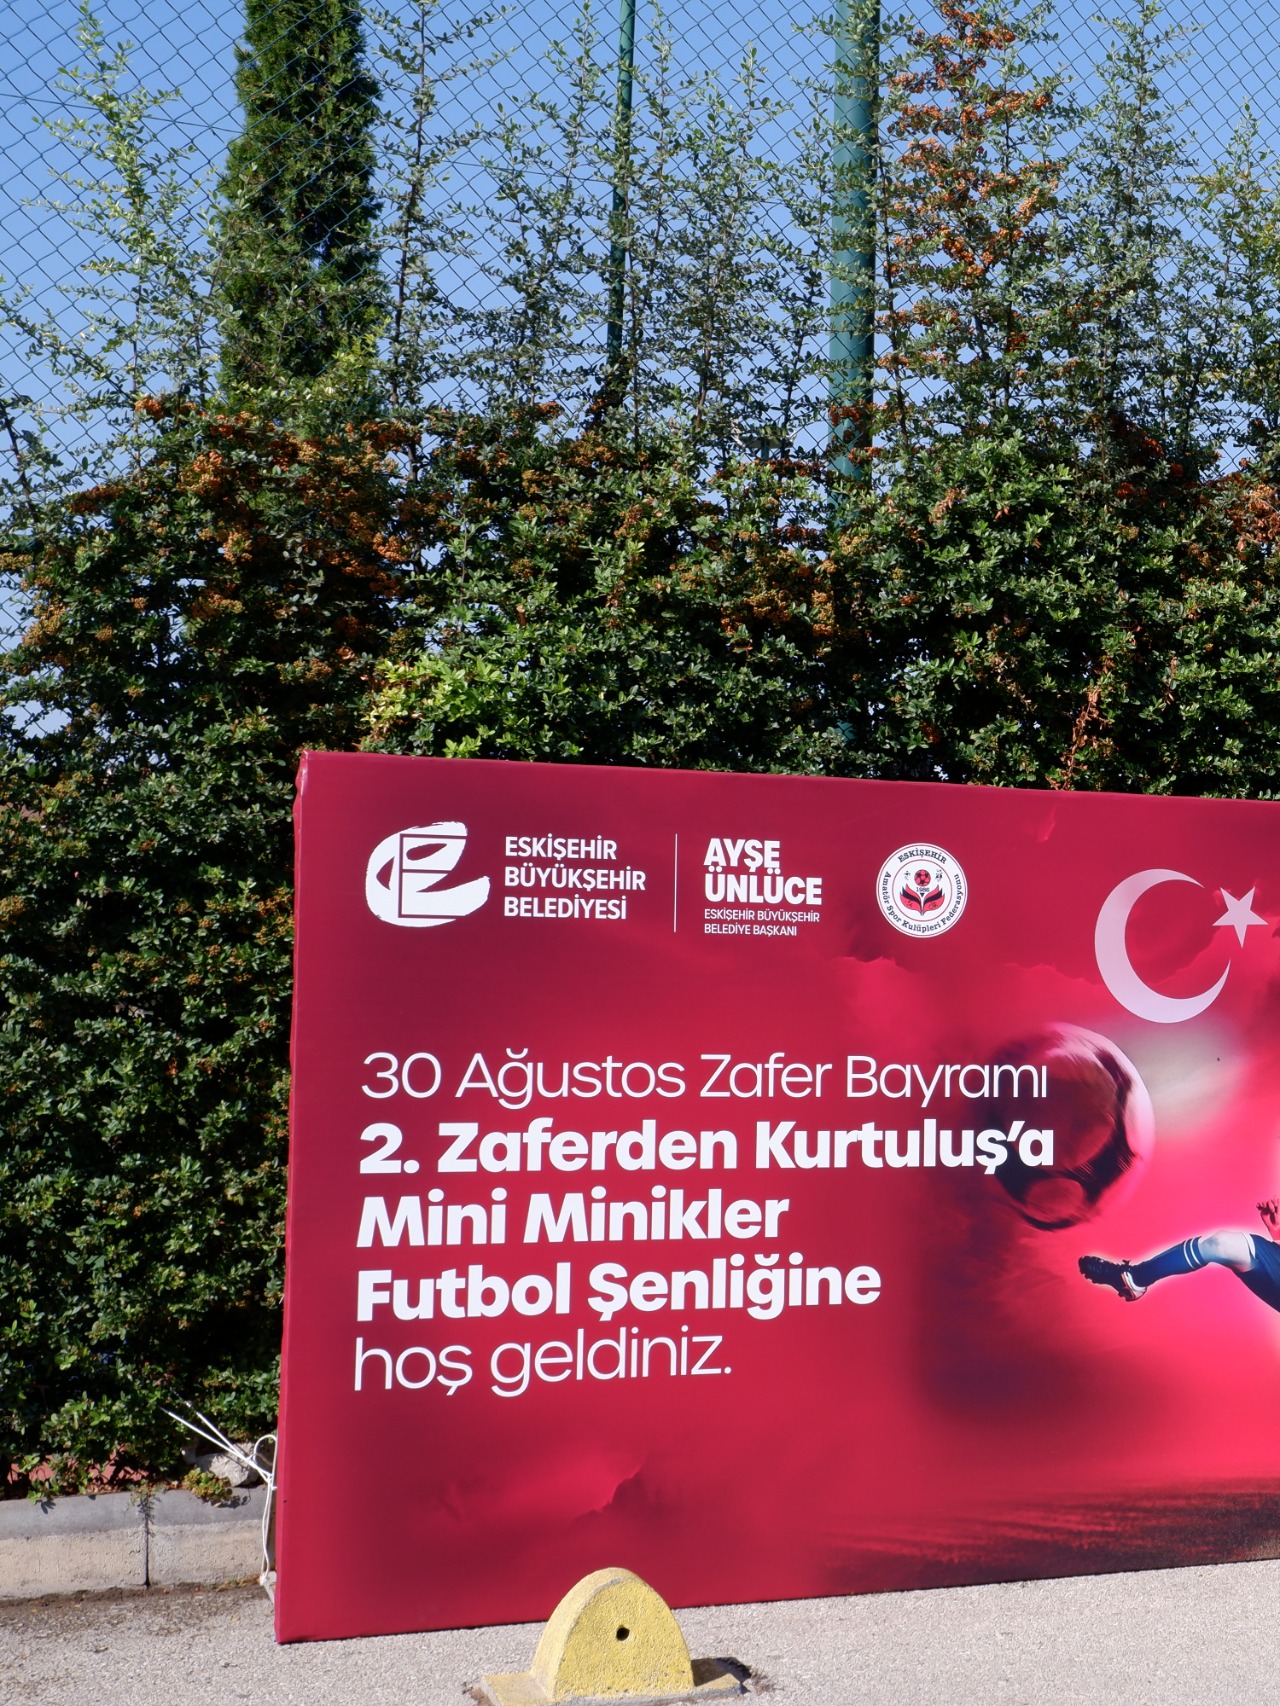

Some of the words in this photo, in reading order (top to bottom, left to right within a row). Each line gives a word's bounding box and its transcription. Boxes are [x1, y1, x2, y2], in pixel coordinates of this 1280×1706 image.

[504, 832, 618, 860] ESKİŞEHİR
[703, 838, 781, 872] AYŞE
[897, 848, 947, 865] ESKİŞEHİR
[504, 862, 647, 891] BÜYÜKŞEHİR
[704, 865, 823, 905] ÜNLÜCE
[882, 871, 892, 904] Amatör
[503, 893, 627, 920] BELEDİYESİ
[704, 907, 755, 920] ESKİŞEHİR
[757, 908, 821, 923] BÜYÜKŞEHİR
[886, 905, 902, 923] Spor
[940, 873, 964, 926] Federasyonu
[704, 922, 751, 935] BELEDİYE
[752, 924, 797, 937] BAŞKANI
[901, 920, 941, 934] Kulüpleri
[360, 1051, 442, 1100] 30
[455, 1047, 687, 1110] Ağustos
[699, 1051, 833, 1099] Zafer
[845, 1054, 1048, 1108] Bayramı
[359, 1122, 420, 1175] 2.
[437, 1116, 738, 1174] Zaferden
[754, 1117, 1055, 1177] Kurtuluş'a
[355, 1187, 507, 1248] Mini
[522, 1184, 790, 1245] Minikler
[356, 1260, 571, 1322] Futbol
[587, 1251, 882, 1321] Şenliğine
[353, 1336, 474, 1396] hoş
[489, 1324, 733, 1398] geldiniz.
